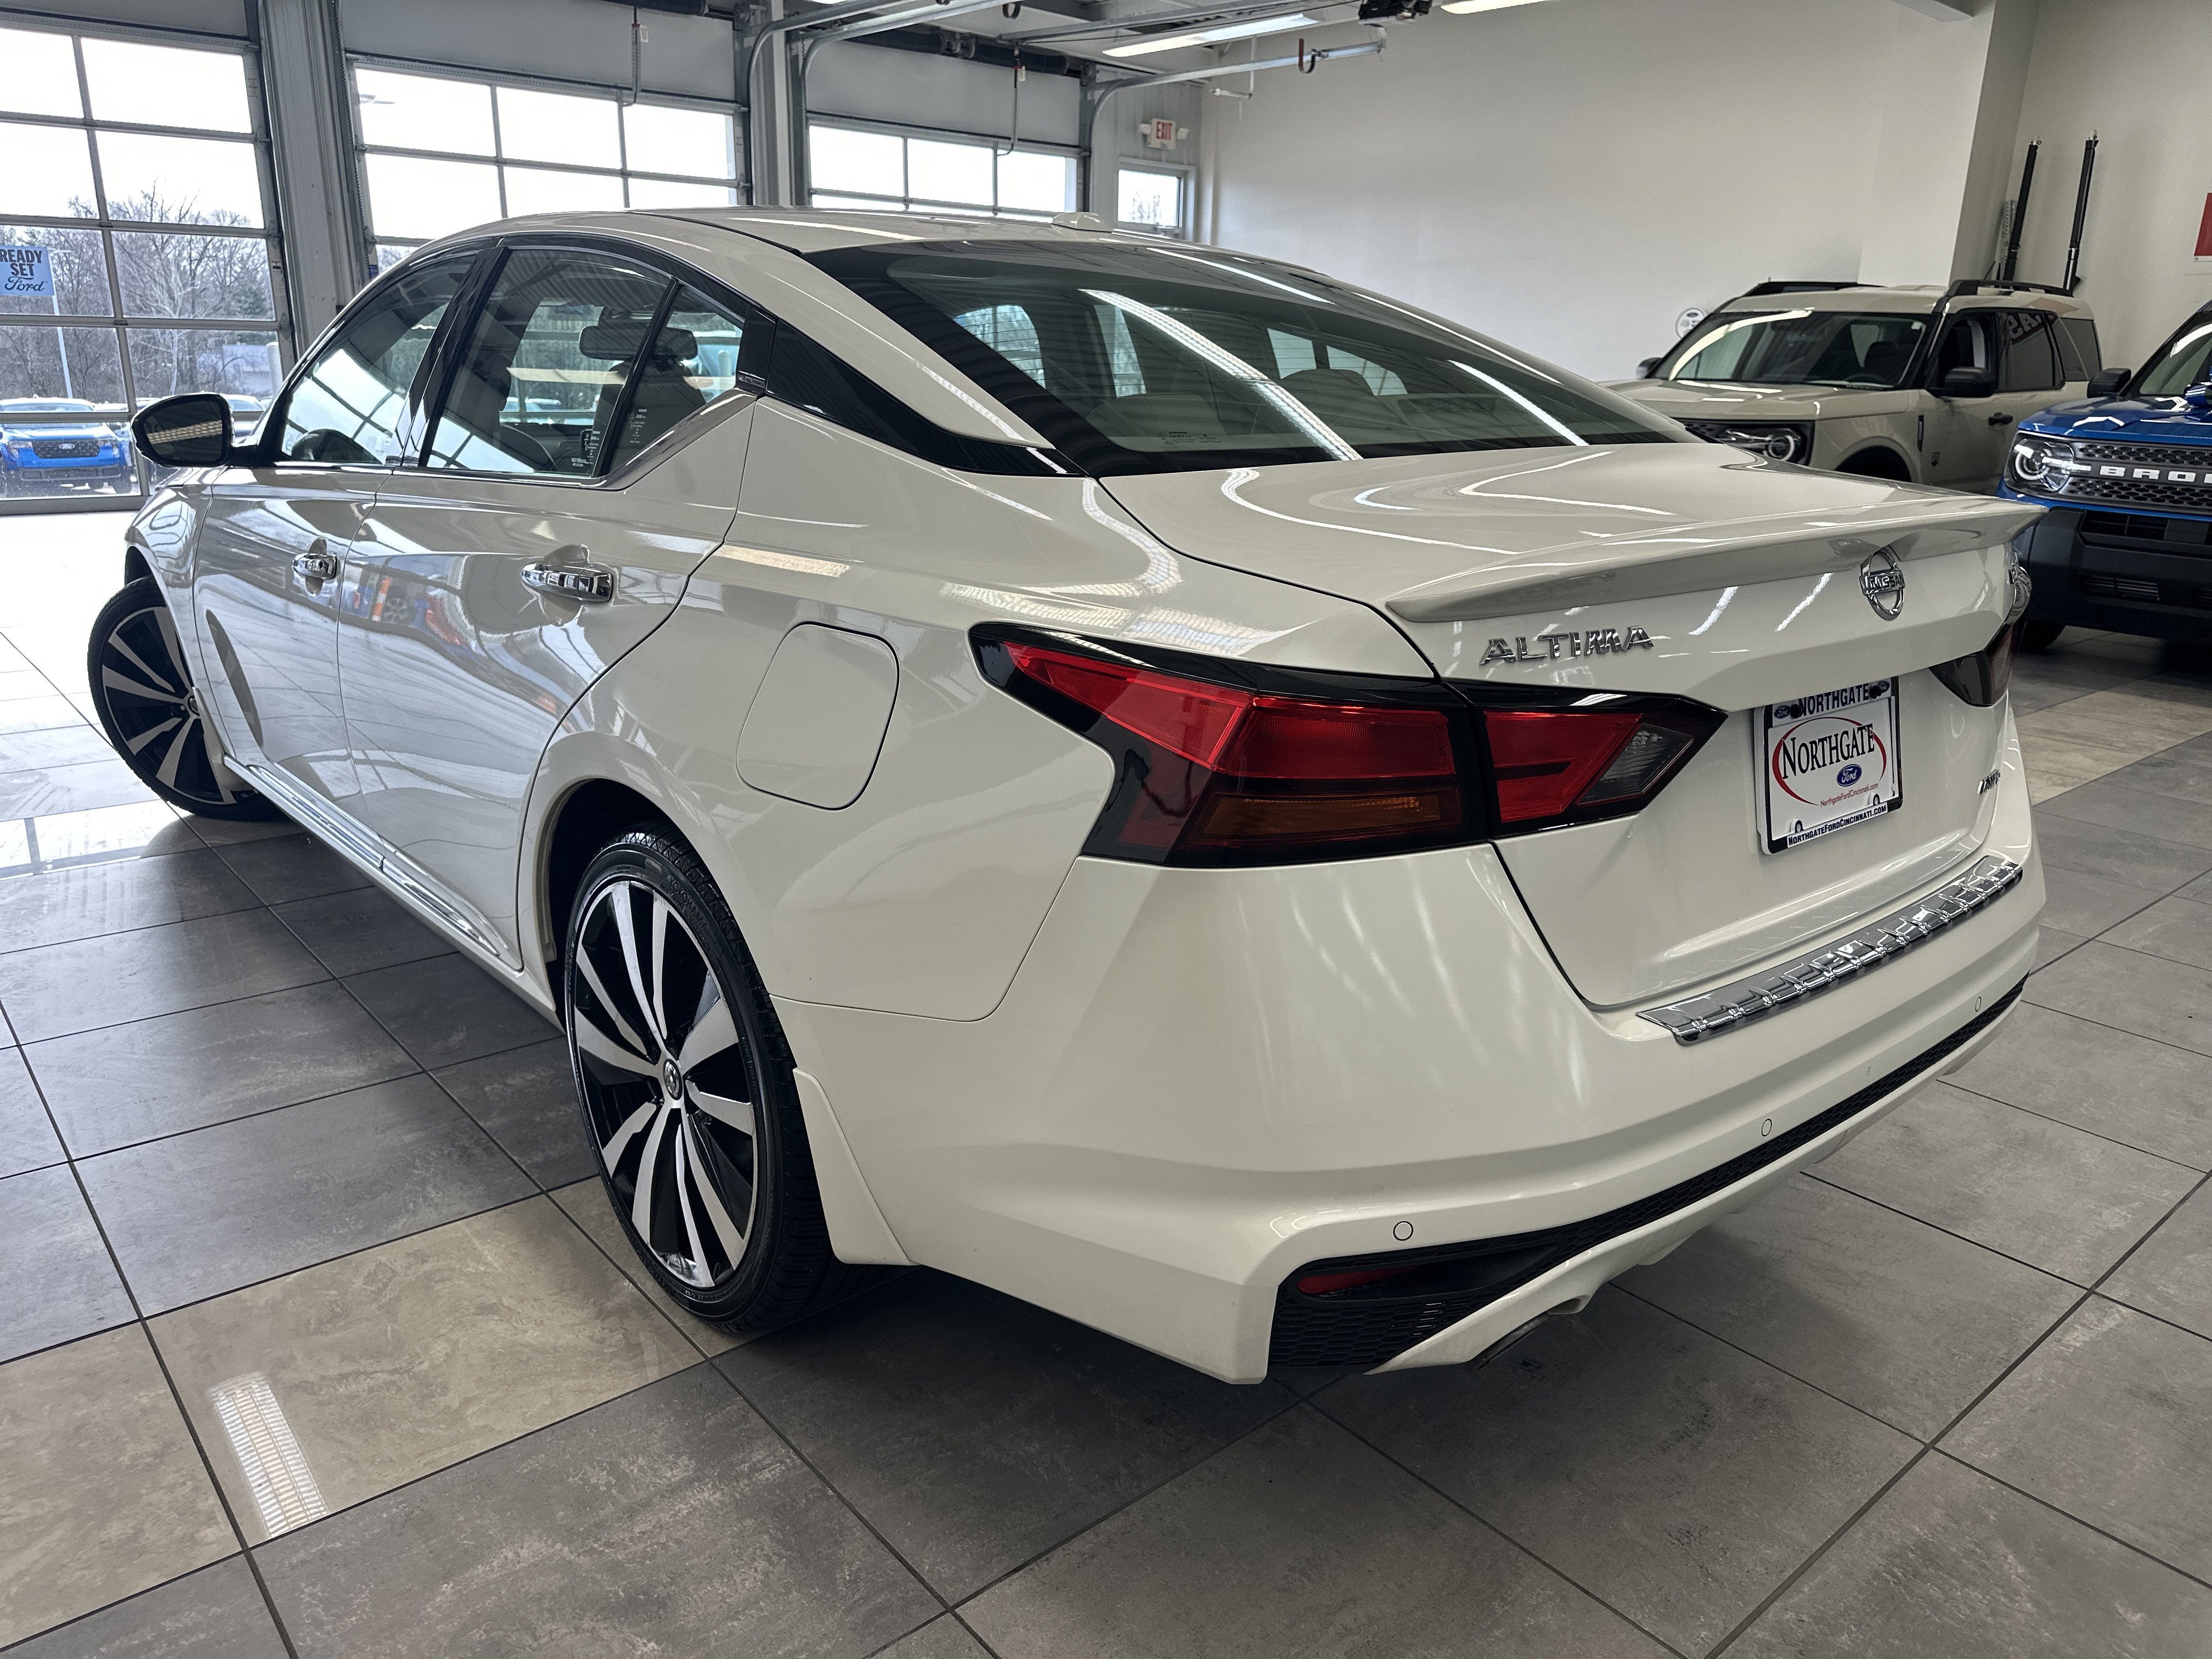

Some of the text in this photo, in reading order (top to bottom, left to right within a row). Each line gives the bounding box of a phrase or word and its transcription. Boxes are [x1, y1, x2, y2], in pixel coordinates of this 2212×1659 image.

[1156, 121, 1173, 140] EXIT
[0, 249, 42, 263] READY
[10, 263, 35, 276] SET
[4, 276, 45, 291] Ford
[1479, 625, 1654, 666] ALTIMA
[1841, 768, 1858, 783] Ford
